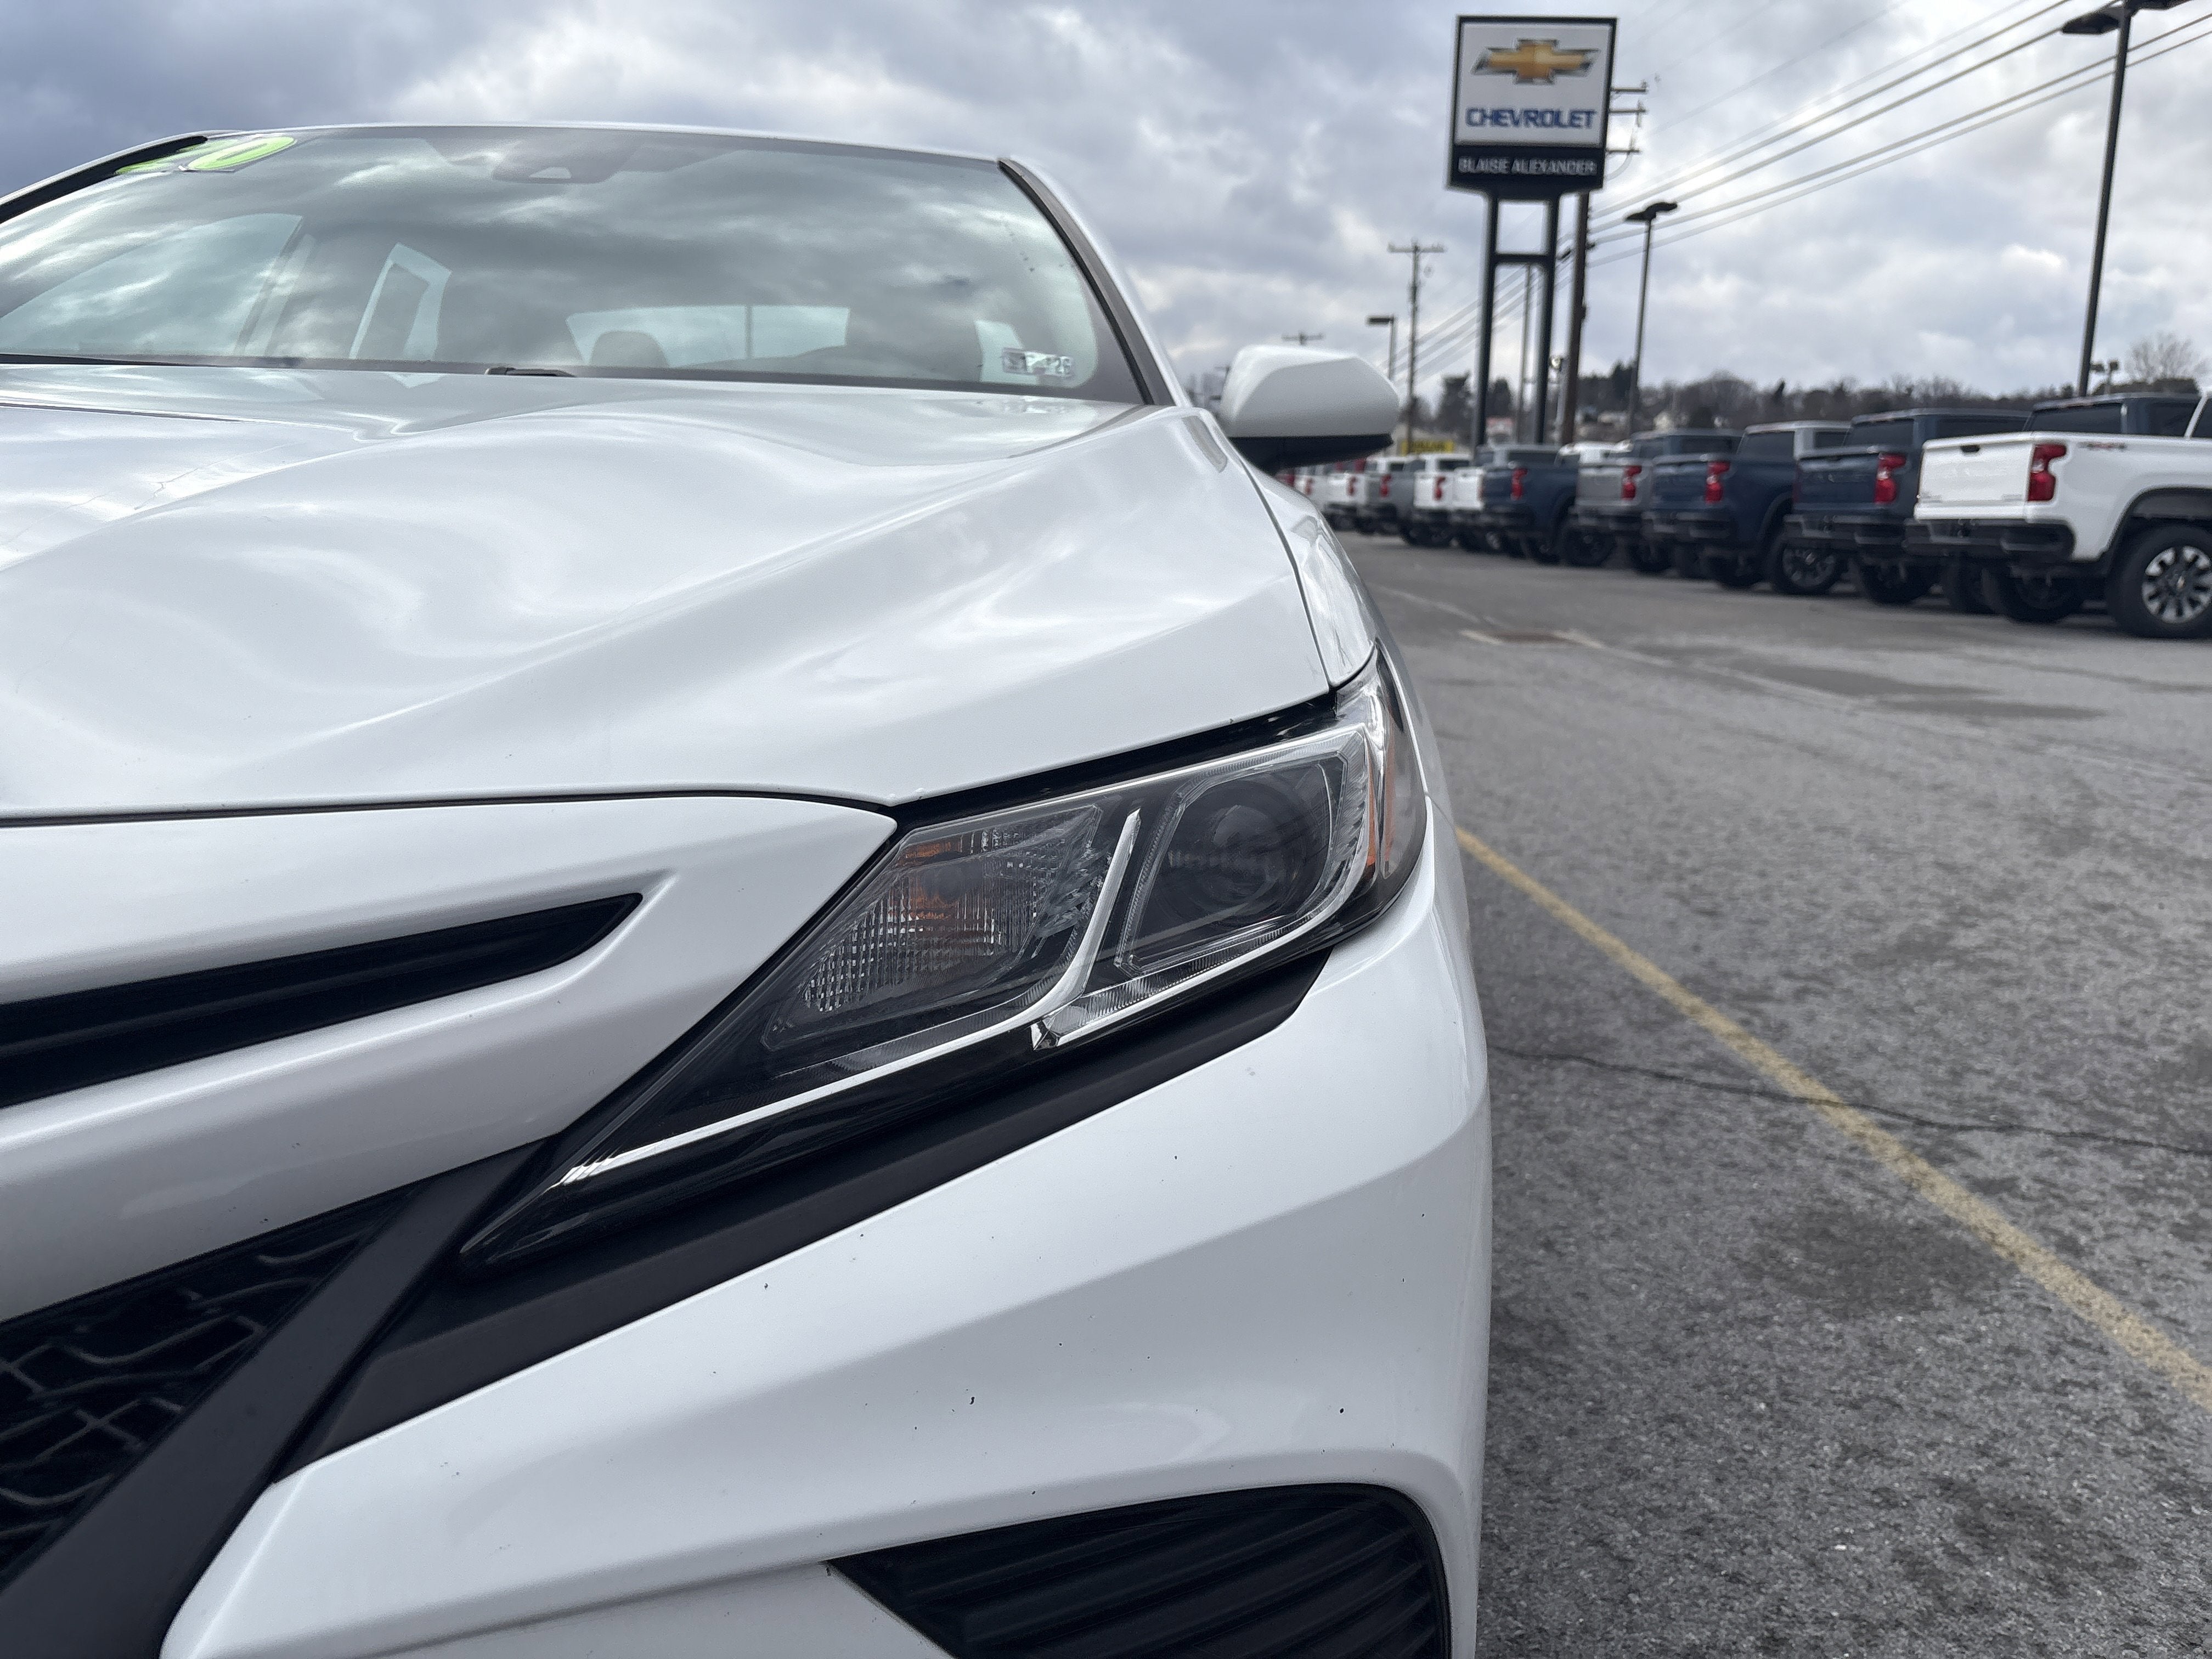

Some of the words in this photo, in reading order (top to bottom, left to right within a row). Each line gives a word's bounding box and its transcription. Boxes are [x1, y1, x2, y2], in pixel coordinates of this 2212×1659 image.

[1465, 108, 1596, 128] CHEVROLET
[1458, 156, 1510, 173] BLAISE
[1511, 157, 1598, 176] ALEXANDER
